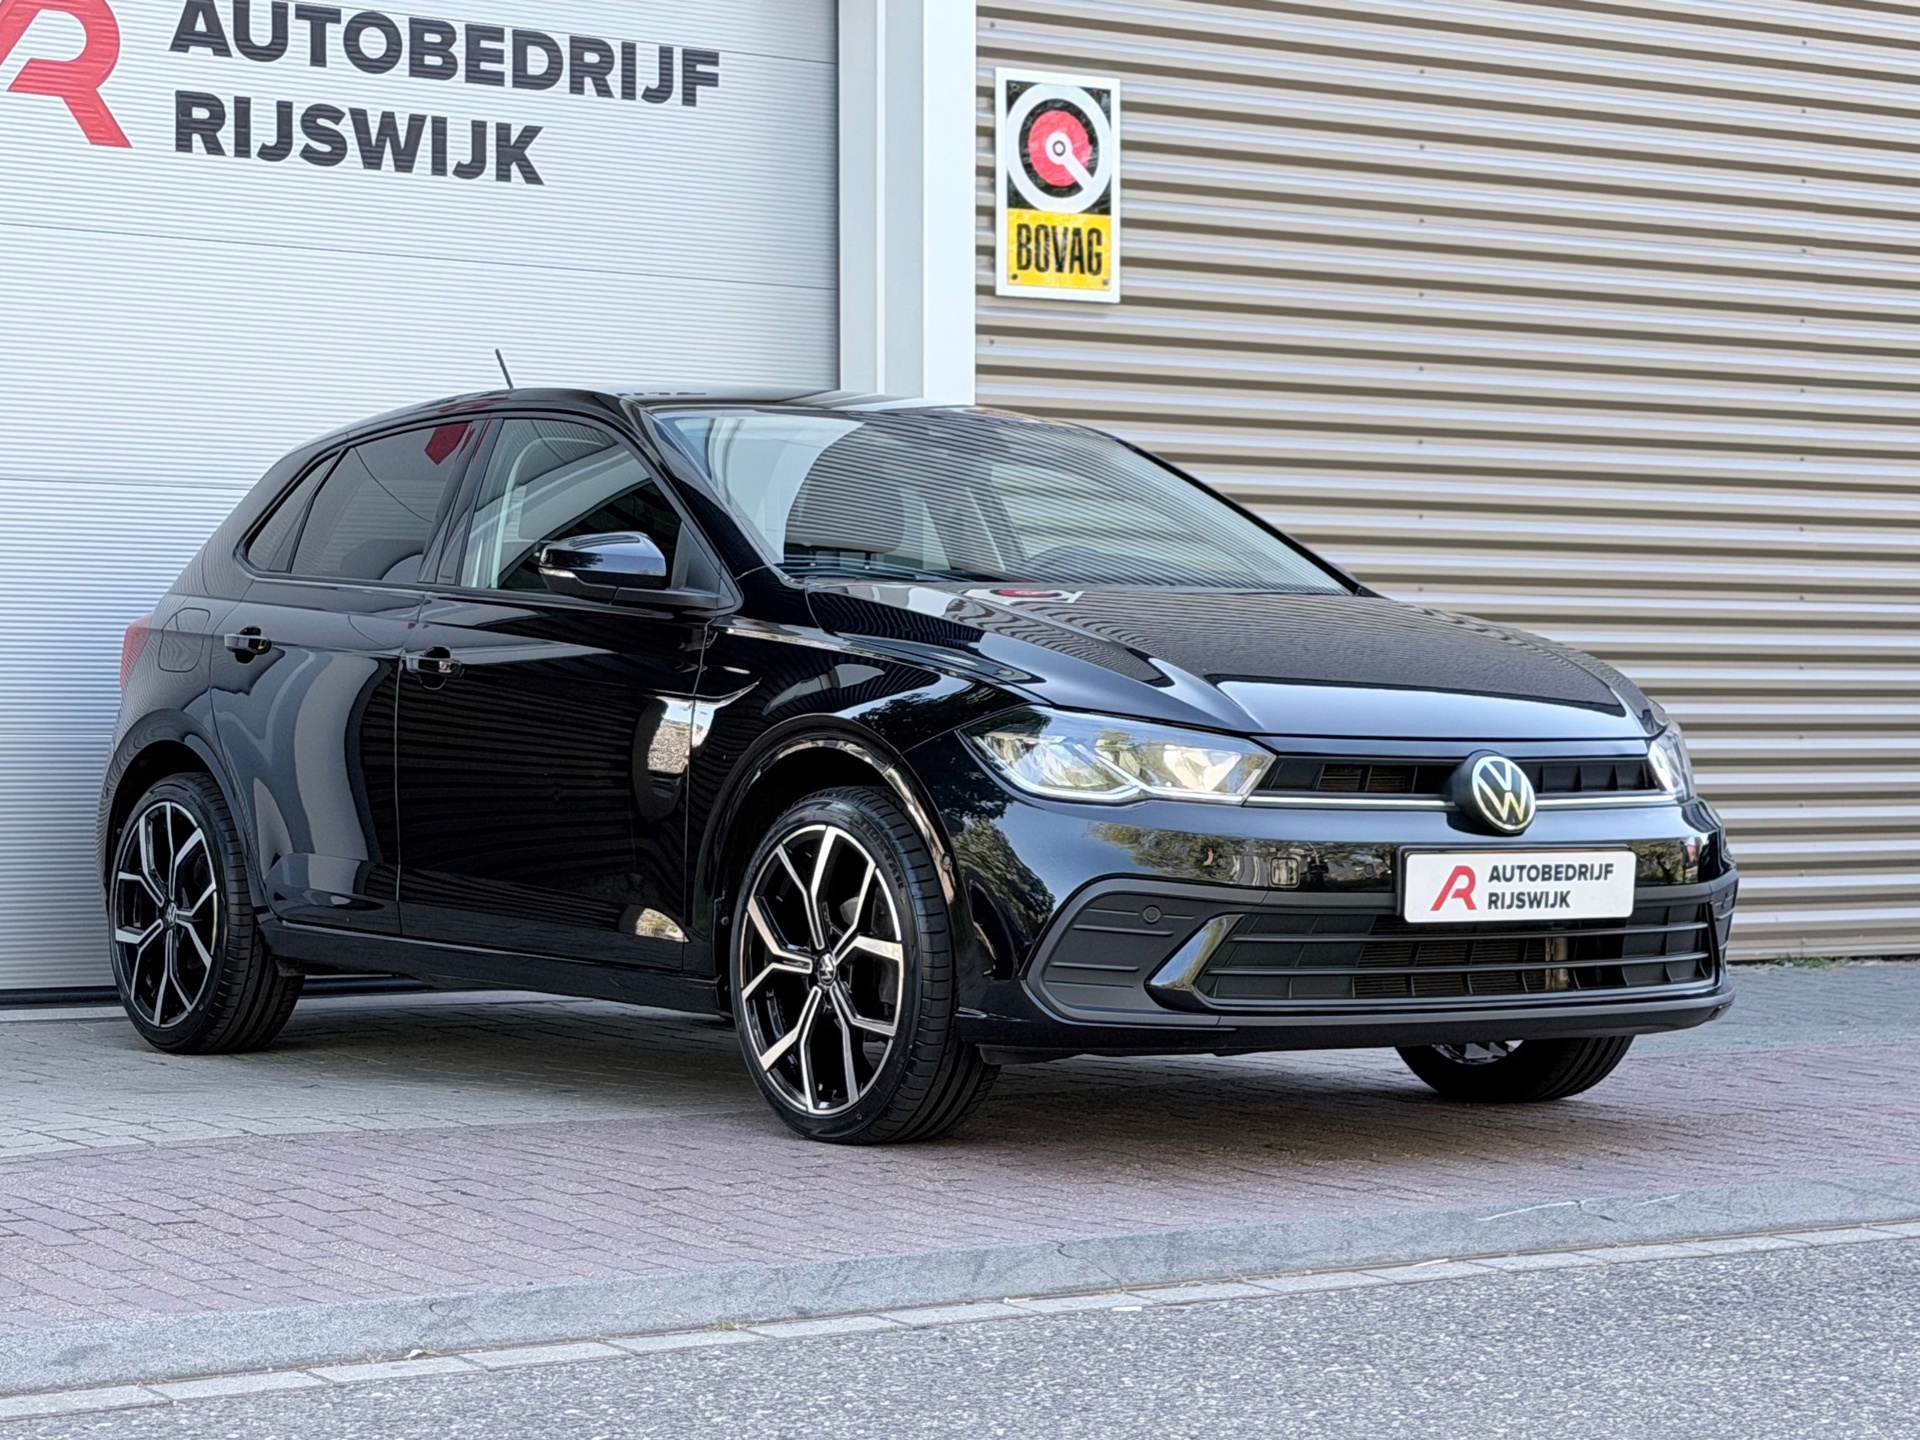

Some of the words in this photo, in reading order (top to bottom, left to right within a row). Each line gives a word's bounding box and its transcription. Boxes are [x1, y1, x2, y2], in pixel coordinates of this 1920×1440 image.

[169, 0, 720, 107] AUTOBEDRIJF
[175, 90, 545, 186] RIJSWIJK
[1016, 223, 1103, 276] BOVAG
[1487, 863, 1614, 883] AUTOBEDRIJF
[1487, 890, 1571, 910] RIJSWIJK
